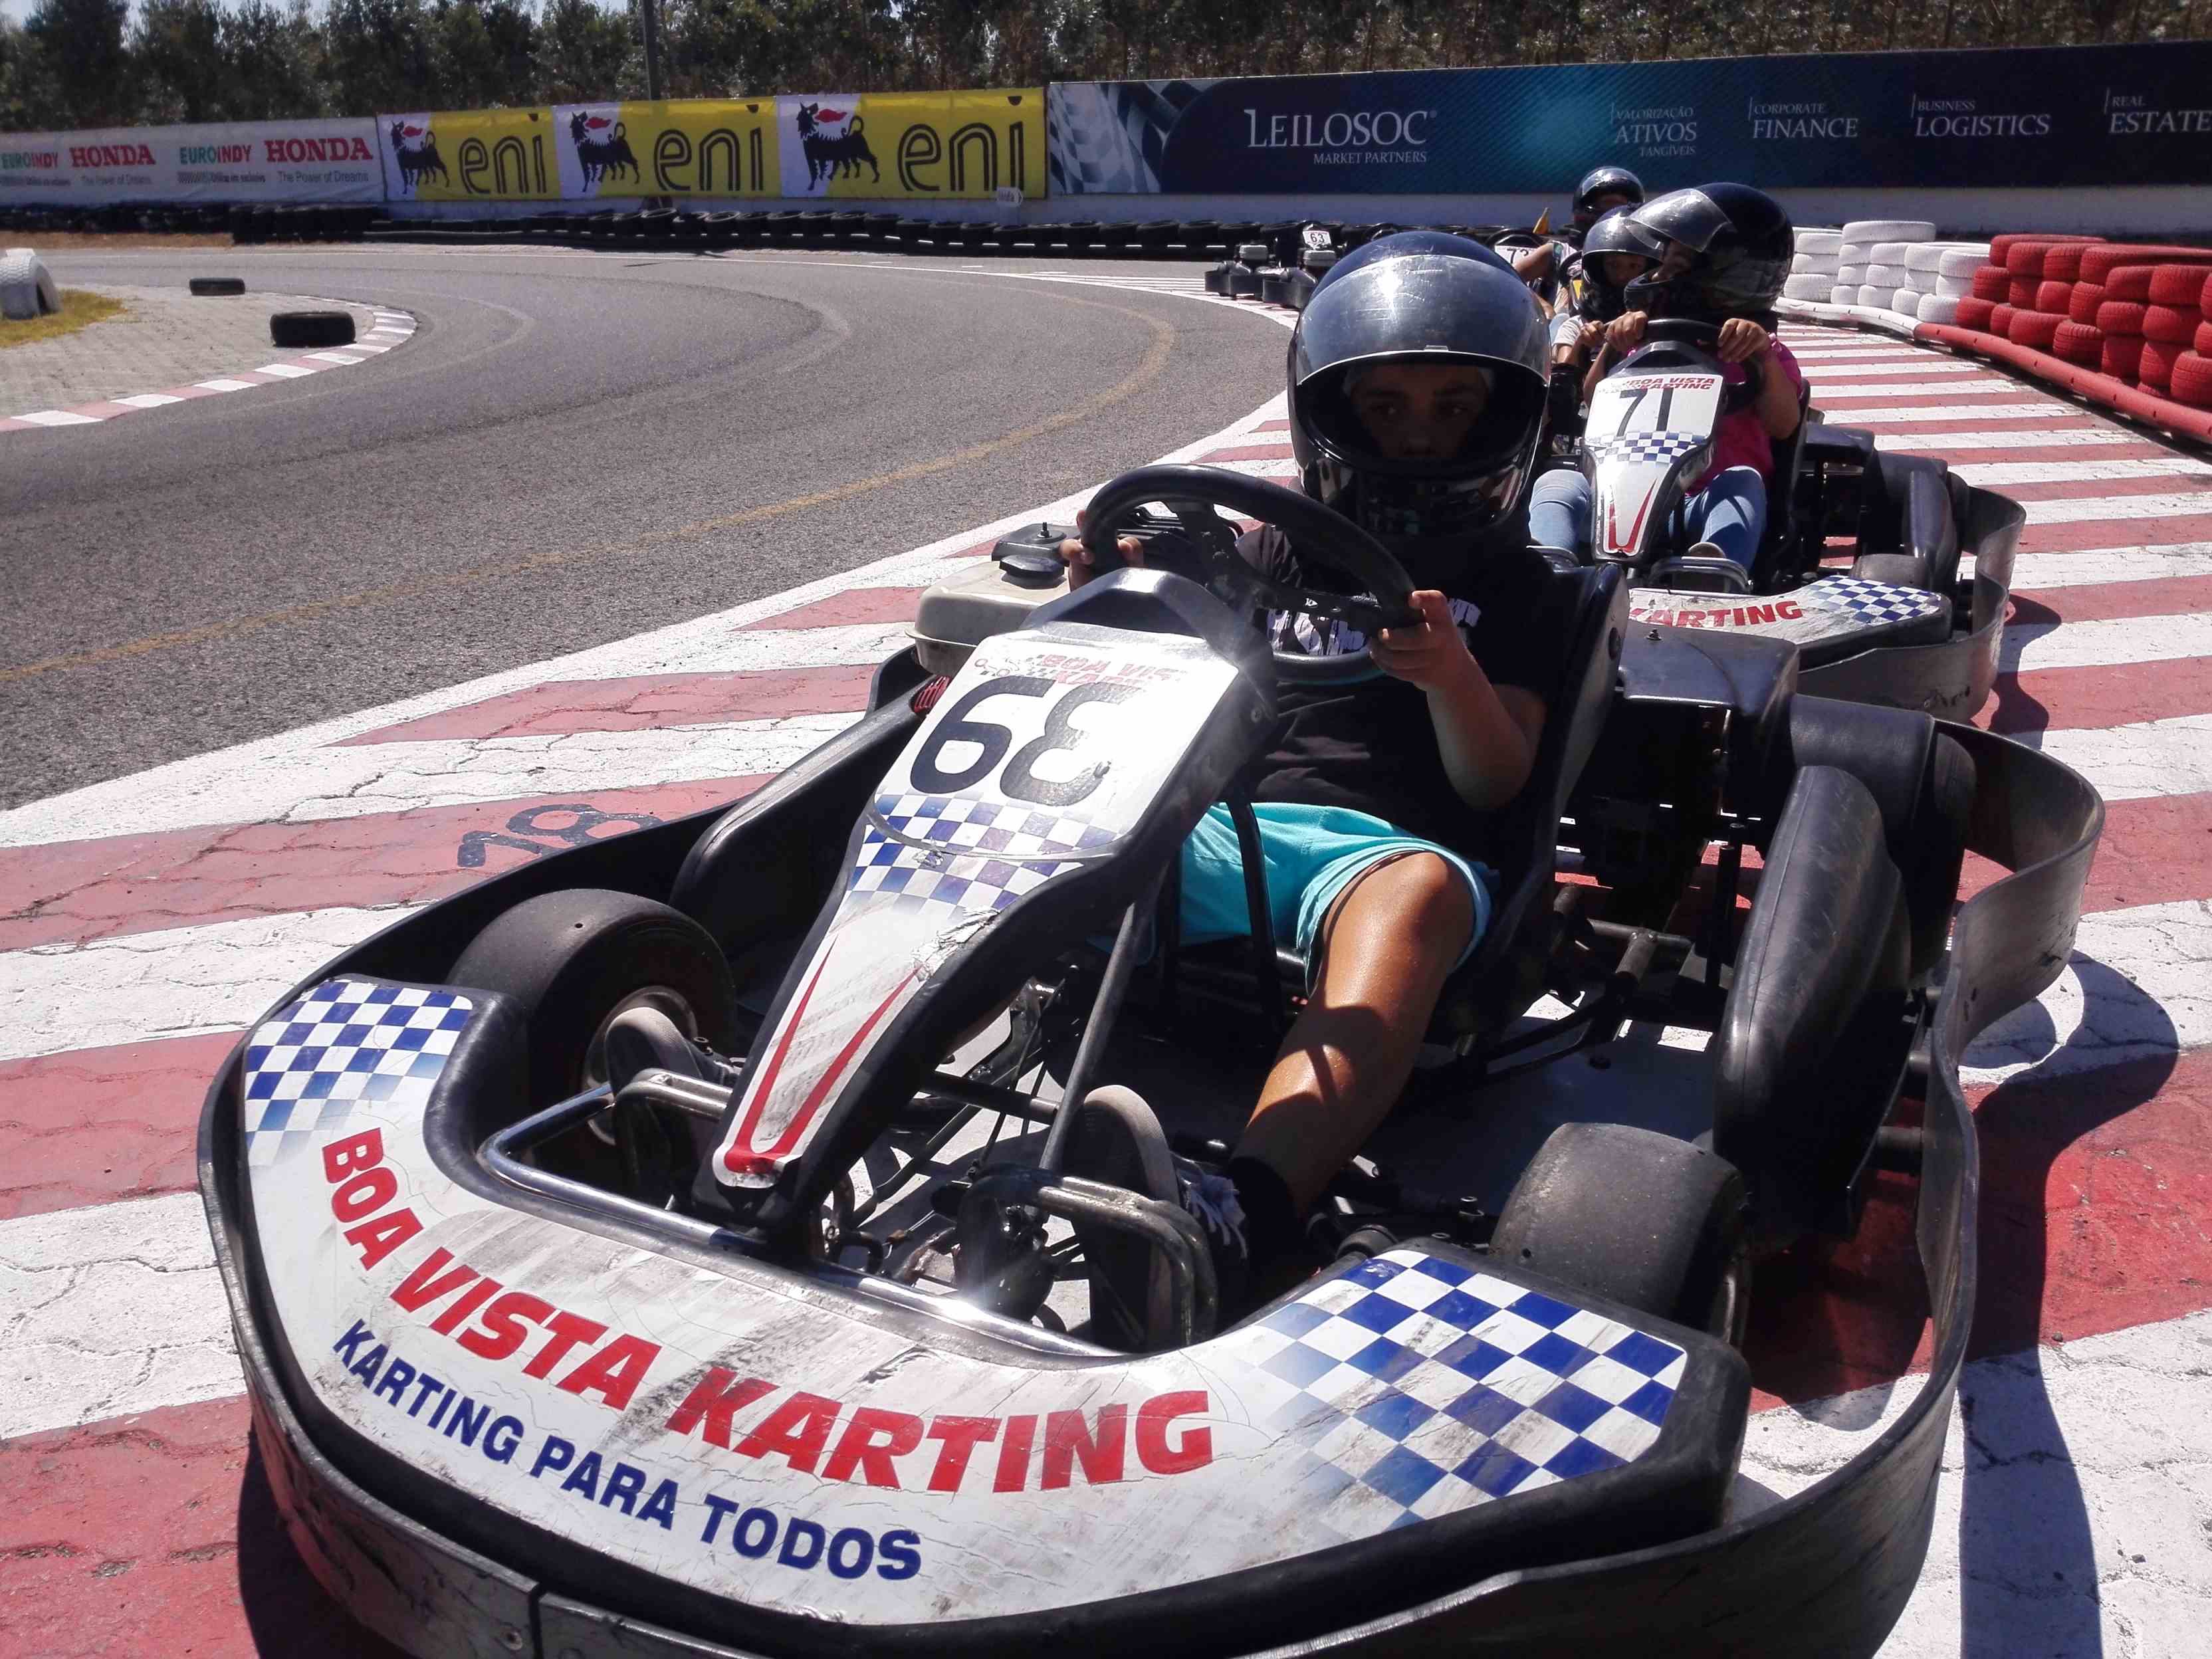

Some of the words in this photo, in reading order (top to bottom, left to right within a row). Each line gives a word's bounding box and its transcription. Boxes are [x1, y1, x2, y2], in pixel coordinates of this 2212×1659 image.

[1753, 102, 1825, 116] CORPORATE
[1918, 100, 1976, 112] BUSINESS
[2112, 95, 2146, 107] REAL
[1244, 108, 1428, 148] LEILOSOC
[1614, 122, 1698, 144] ATIVOS
[1752, 117, 1860, 139] FINANCE
[1915, 113, 2051, 138] LOGISTICS
[2109, 110, 2212, 134] ESTATE
[68, 144, 157, 167] HONDA
[264, 137, 374, 163] HONDA
[459, 112, 547, 194] eni
[653, 104, 764, 191] eni
[897, 95, 1025, 192] eni
[1313, 152, 1363, 166] MARKET
[1365, 151, 1428, 164] PARTNERS
[278, 171, 292, 182] The
[296, 170, 322, 183] Power
[324, 170, 333, 183] of
[334, 169, 369, 182] Dreams
[1310, 233, 1325, 243] 63
[1616, 388, 1674, 437] 71
[910, 675, 1143, 806] 63
[322, 1127, 424, 1271] BOA
[389, 1246, 662, 1411] VISTA
[664, 1366, 1213, 1493] KARTING
[332, 1318, 524, 1464] KARTING
[530, 1434, 679, 1531] PARA
[700, 1493, 923, 1581] TODOS
